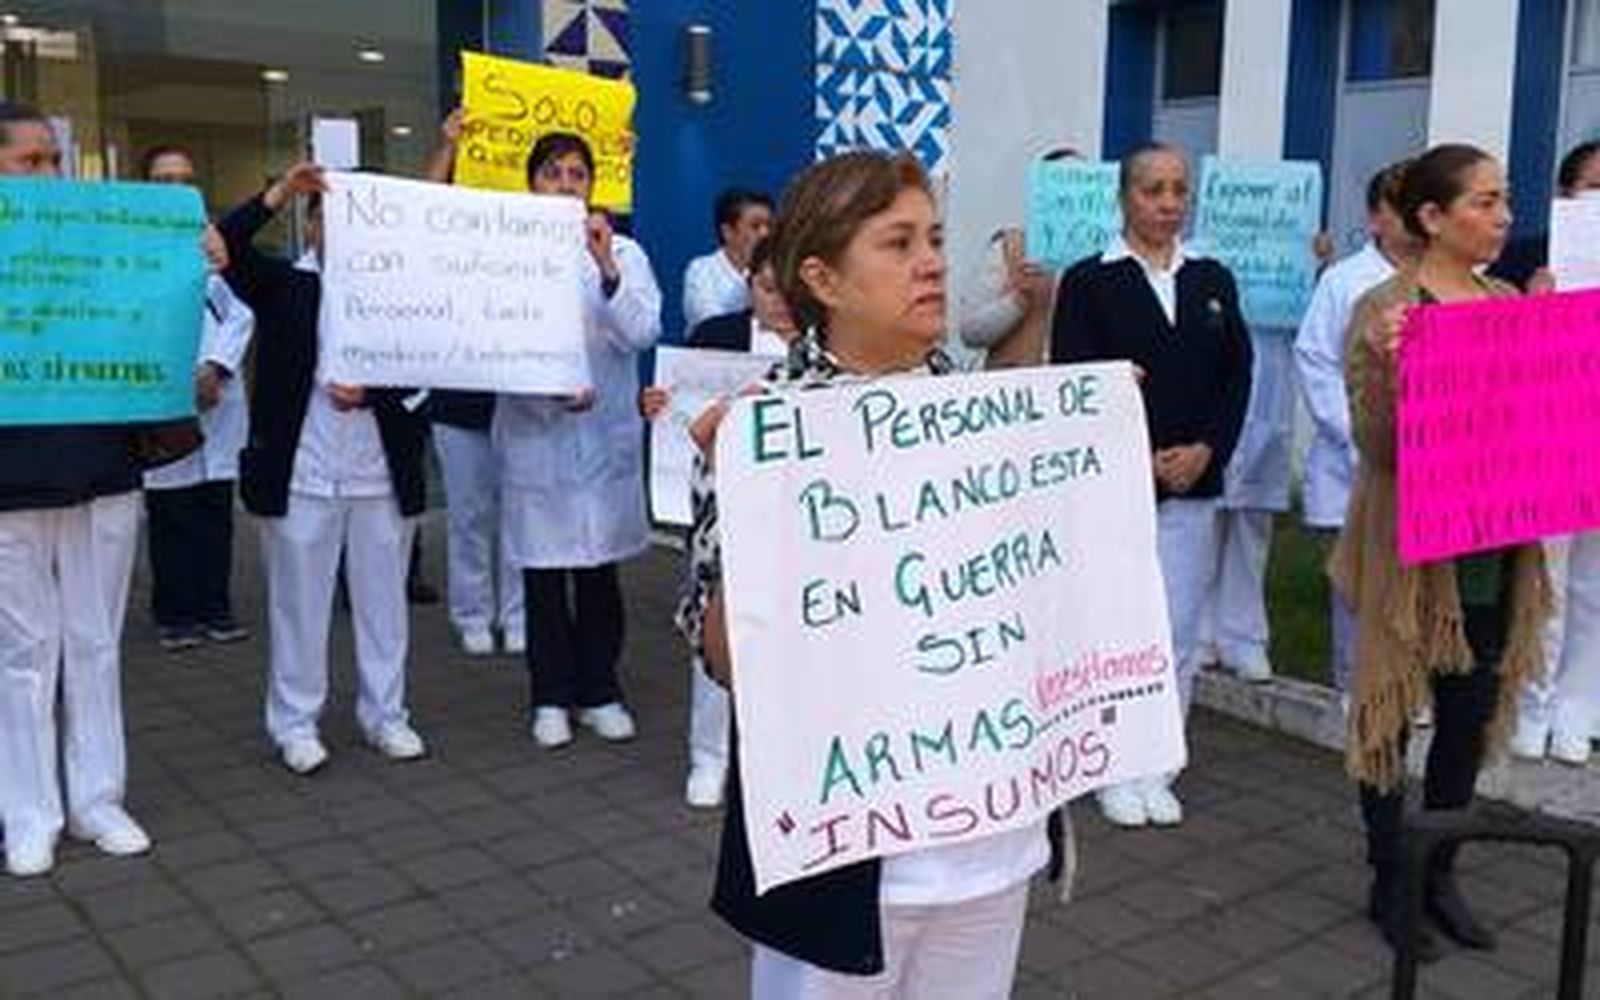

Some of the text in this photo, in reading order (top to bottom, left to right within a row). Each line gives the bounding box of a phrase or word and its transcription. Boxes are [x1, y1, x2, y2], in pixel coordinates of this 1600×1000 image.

[346, 184, 404, 229] No
[347, 252, 405, 273] con
[751, 397, 825, 464] EL
[854, 386, 1046, 452] PERSONAL
[1058, 374, 1101, 417] DE
[800, 446, 1103, 543] BLANCO ESTA
[802, 529, 1062, 627] EN GUERRA
[917, 612, 1027, 675] SIN
[819, 697, 1036, 805] ARMAS
